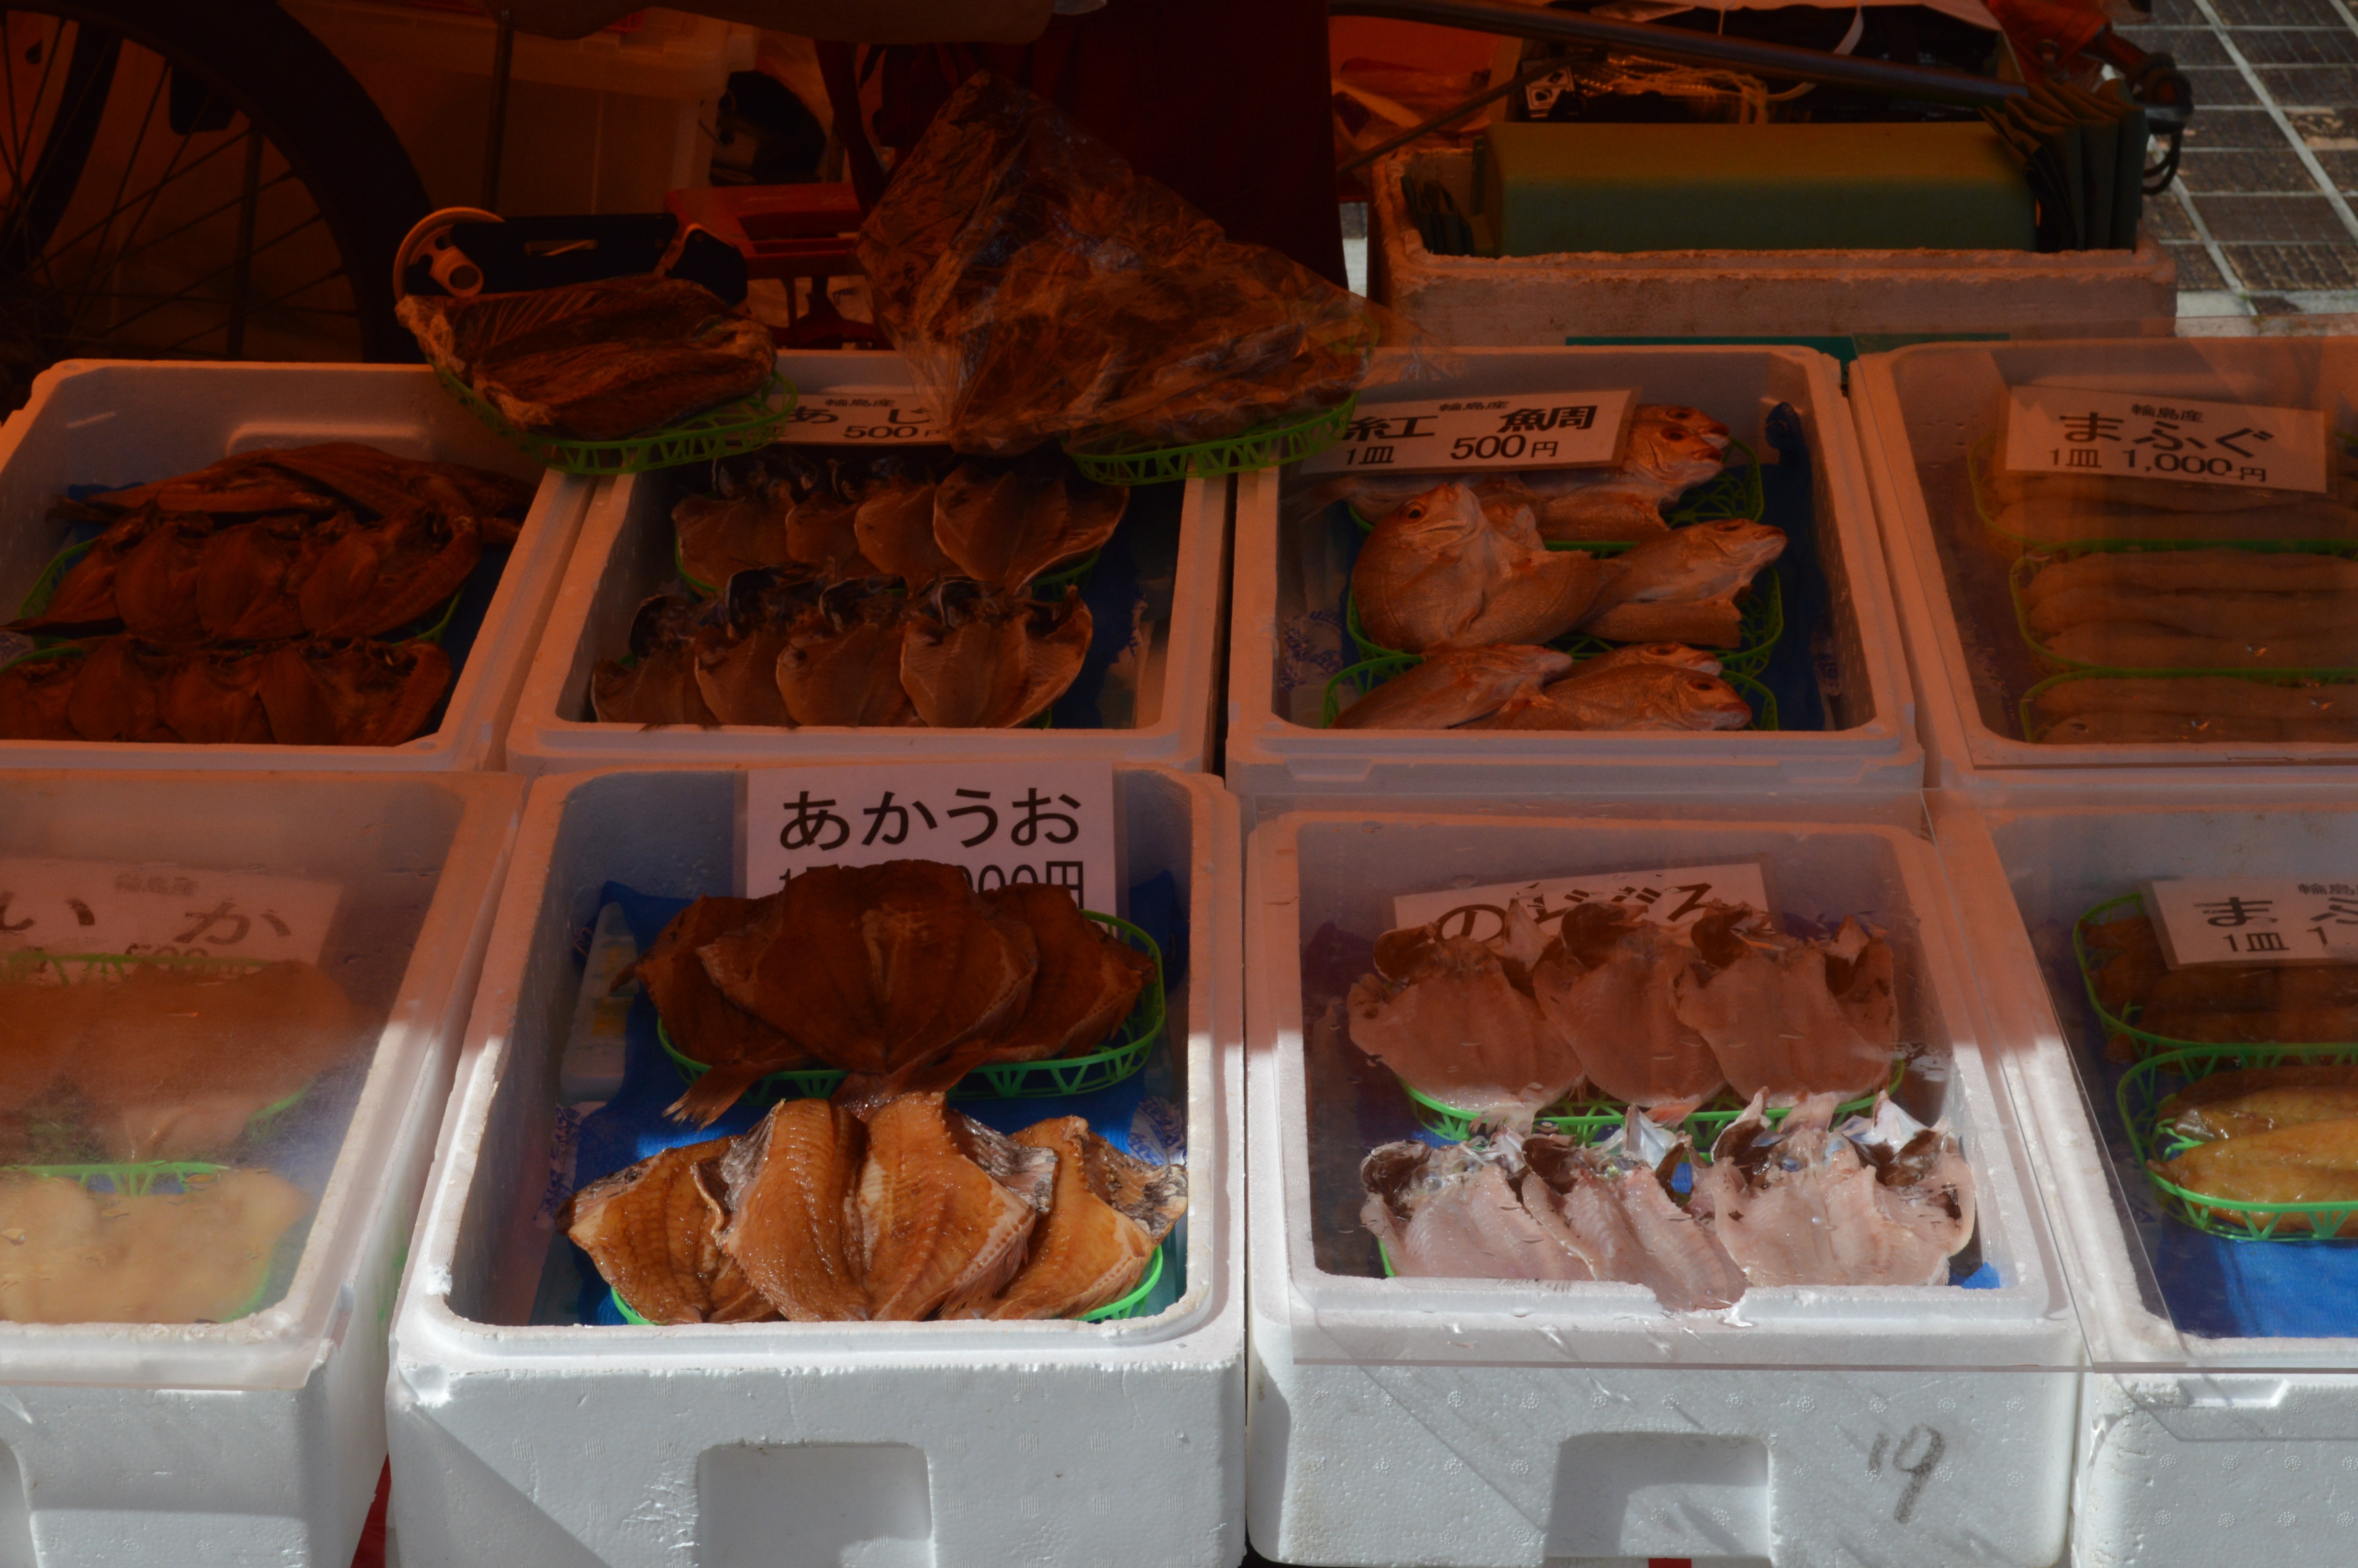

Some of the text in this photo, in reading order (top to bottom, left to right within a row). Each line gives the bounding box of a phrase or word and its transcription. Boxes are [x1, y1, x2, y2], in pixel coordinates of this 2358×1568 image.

[1439, 401, 1509, 411] 輪島産
[2131, 403, 2204, 422] 輪島産
[1346, 434, 1558, 465] 1皿 500円
[2059, 412, 2274, 458] まふぐ
[2050, 448, 2267, 482] 1皿 1,000円
[779, 788, 1082, 851] あかうお
[2298, 883, 2358, 895] 輪島
[2222, 933, 2290, 952] 1皿
[1867, 1422, 1946, 1525] 19
